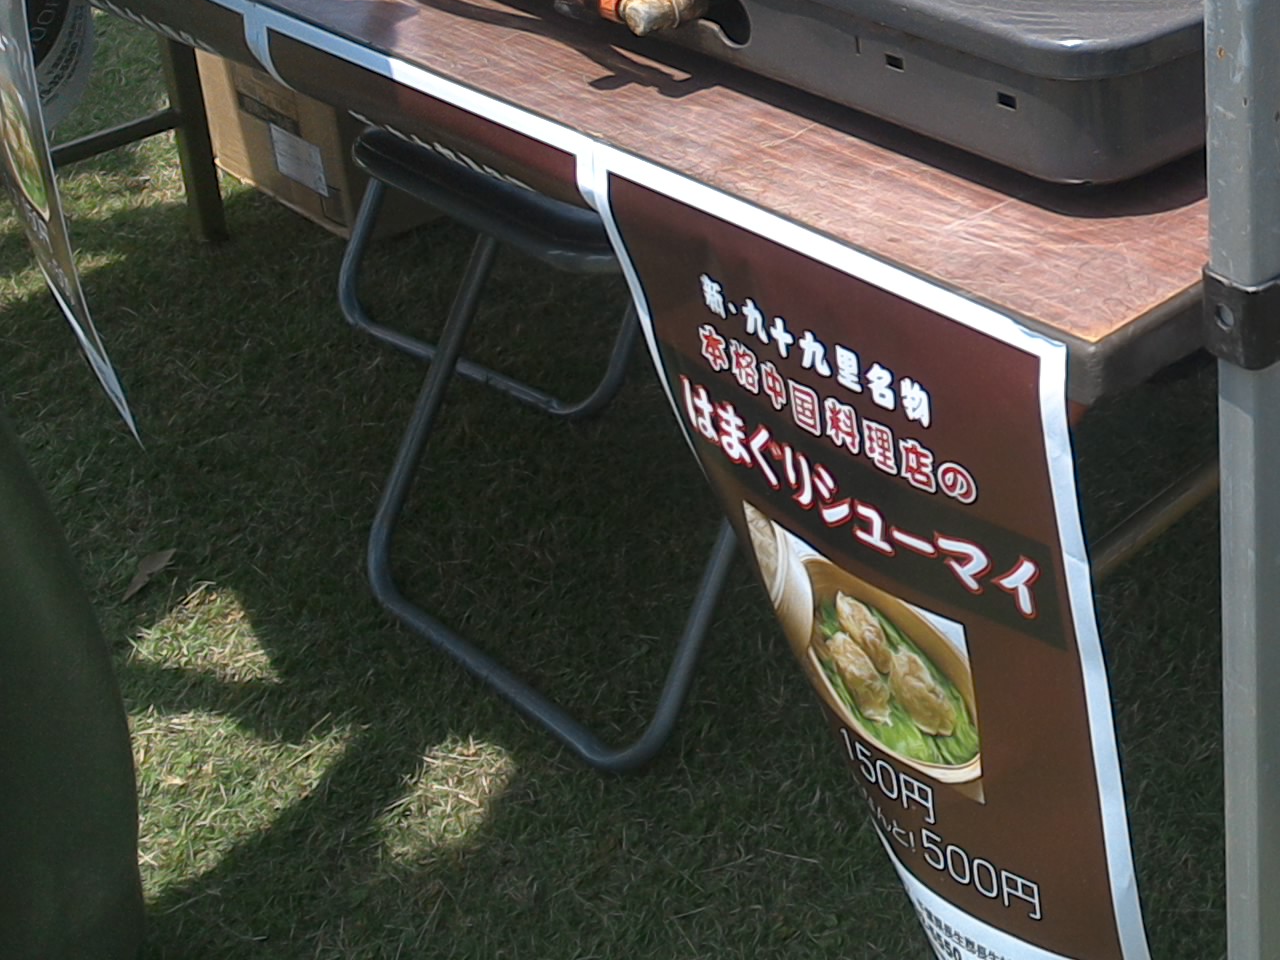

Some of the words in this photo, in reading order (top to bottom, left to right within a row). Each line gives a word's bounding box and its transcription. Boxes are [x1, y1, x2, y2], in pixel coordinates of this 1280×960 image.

[700, 326, 977, 504] 本格中国料理店の
[679, 375, 1041, 619] はまぐりシューマイ
[840, 727, 936, 825] 150円
[921, 827, 1043, 921] 500円
